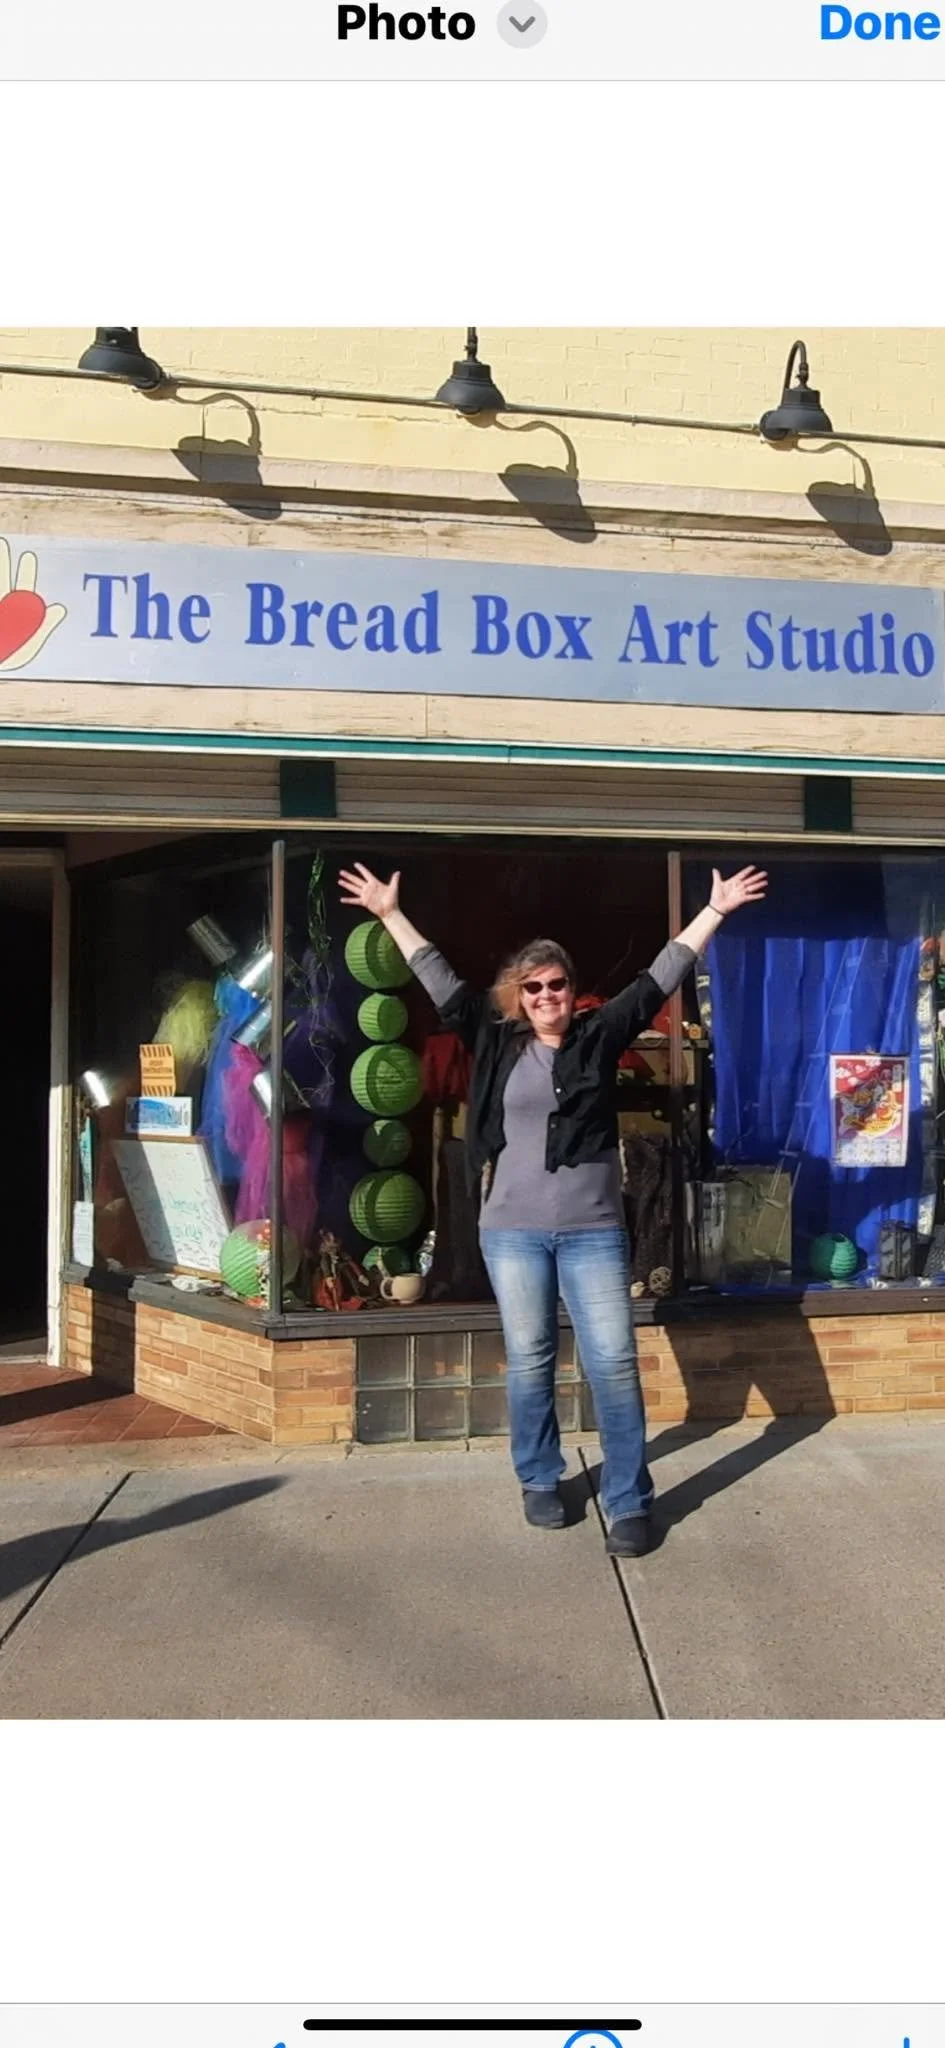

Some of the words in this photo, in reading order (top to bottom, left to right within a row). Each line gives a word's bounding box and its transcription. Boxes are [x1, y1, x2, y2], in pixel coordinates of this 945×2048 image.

[83, 572, 212, 645] The
[245, 582, 441, 656] Bread
[472, 594, 594, 661] Box
[618, 604, 718, 668] Art
[745, 610, 936, 678] Studio
